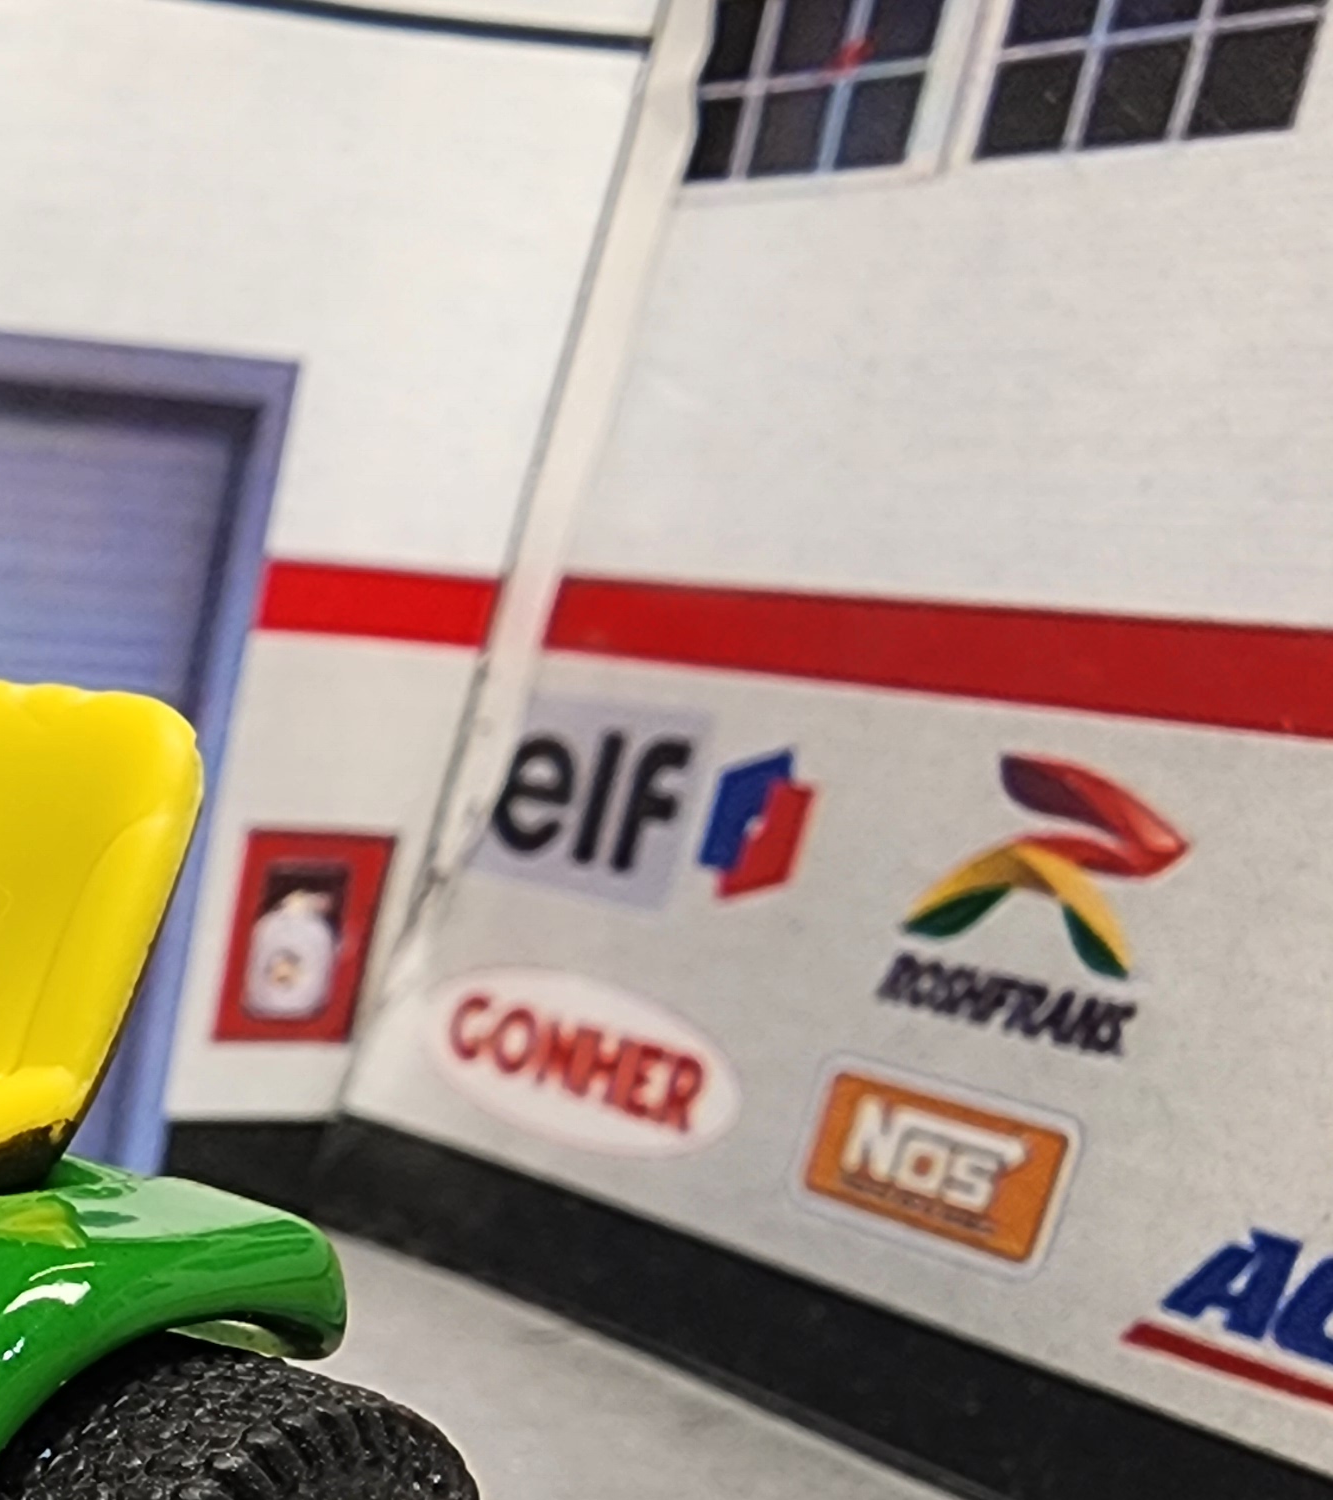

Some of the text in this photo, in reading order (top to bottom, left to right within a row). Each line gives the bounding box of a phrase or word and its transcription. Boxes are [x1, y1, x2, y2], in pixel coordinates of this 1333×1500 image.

[491, 728, 692, 874] elf
[449, 993, 703, 1134] CONHER
[878, 951, 1137, 1056] ROSHFRANS
[840, 1093, 1027, 1214] NOS
